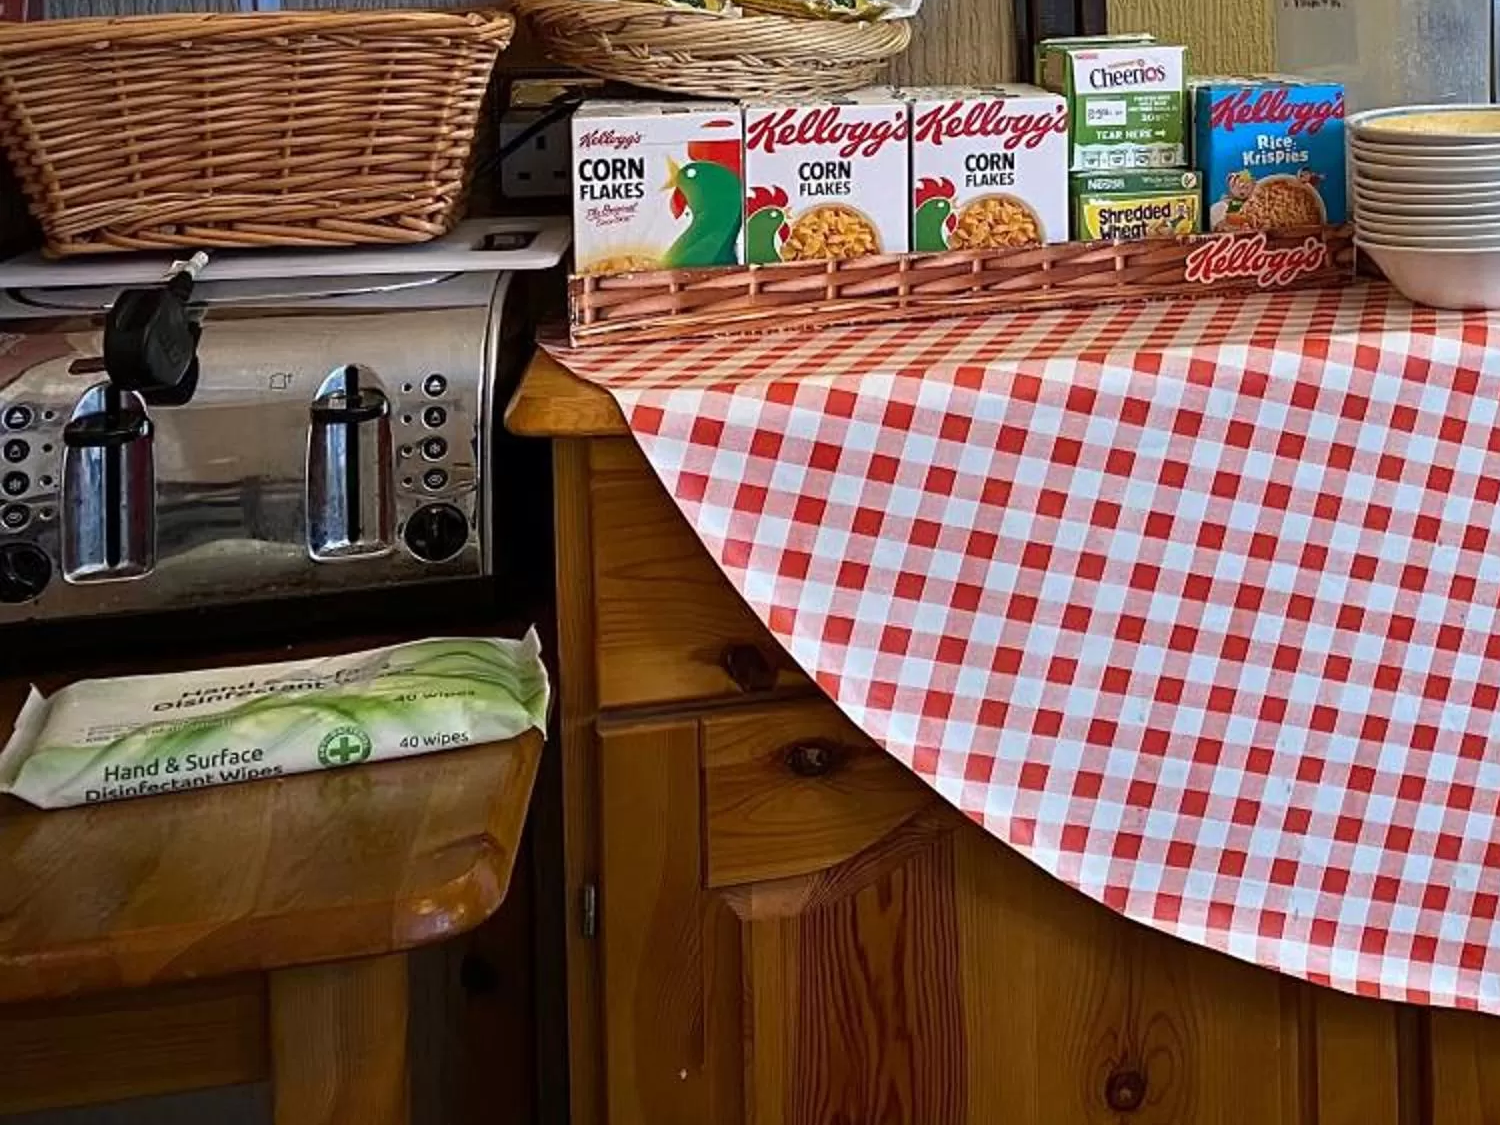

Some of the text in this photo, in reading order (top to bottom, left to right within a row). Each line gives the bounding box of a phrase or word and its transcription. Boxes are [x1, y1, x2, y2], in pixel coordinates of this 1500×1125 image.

[1089, 59, 1166, 88] Cheerios
[1209, 89, 1344, 135] Kellogg's
[747, 106, 908, 158] Kellogg's
[915, 100, 1067, 150] Kellogg's
[579, 129, 641, 150] Kellogg's
[1257, 134, 1292, 150] Rice
[965, 152, 1015, 172] CORN
[1242, 150, 1309, 166] Krispies
[579, 157, 645, 182] CORN
[798, 161, 851, 181] CORN
[965, 172, 1015, 188] FLAKES
[580, 182, 645, 201] FLAKES
[799, 181, 851, 196] FLAKES
[1098, 202, 1171, 225] Shredded
[1185, 232, 1326, 287] Kellogg's
[153, 679, 325, 712] Disinfectant
[182, 682, 255, 698] Hand
[399, 731, 469, 748] 40 wipes
[104, 747, 264, 783] Hand & Surface
[85, 765, 284, 803] Disinfectant Wipes
